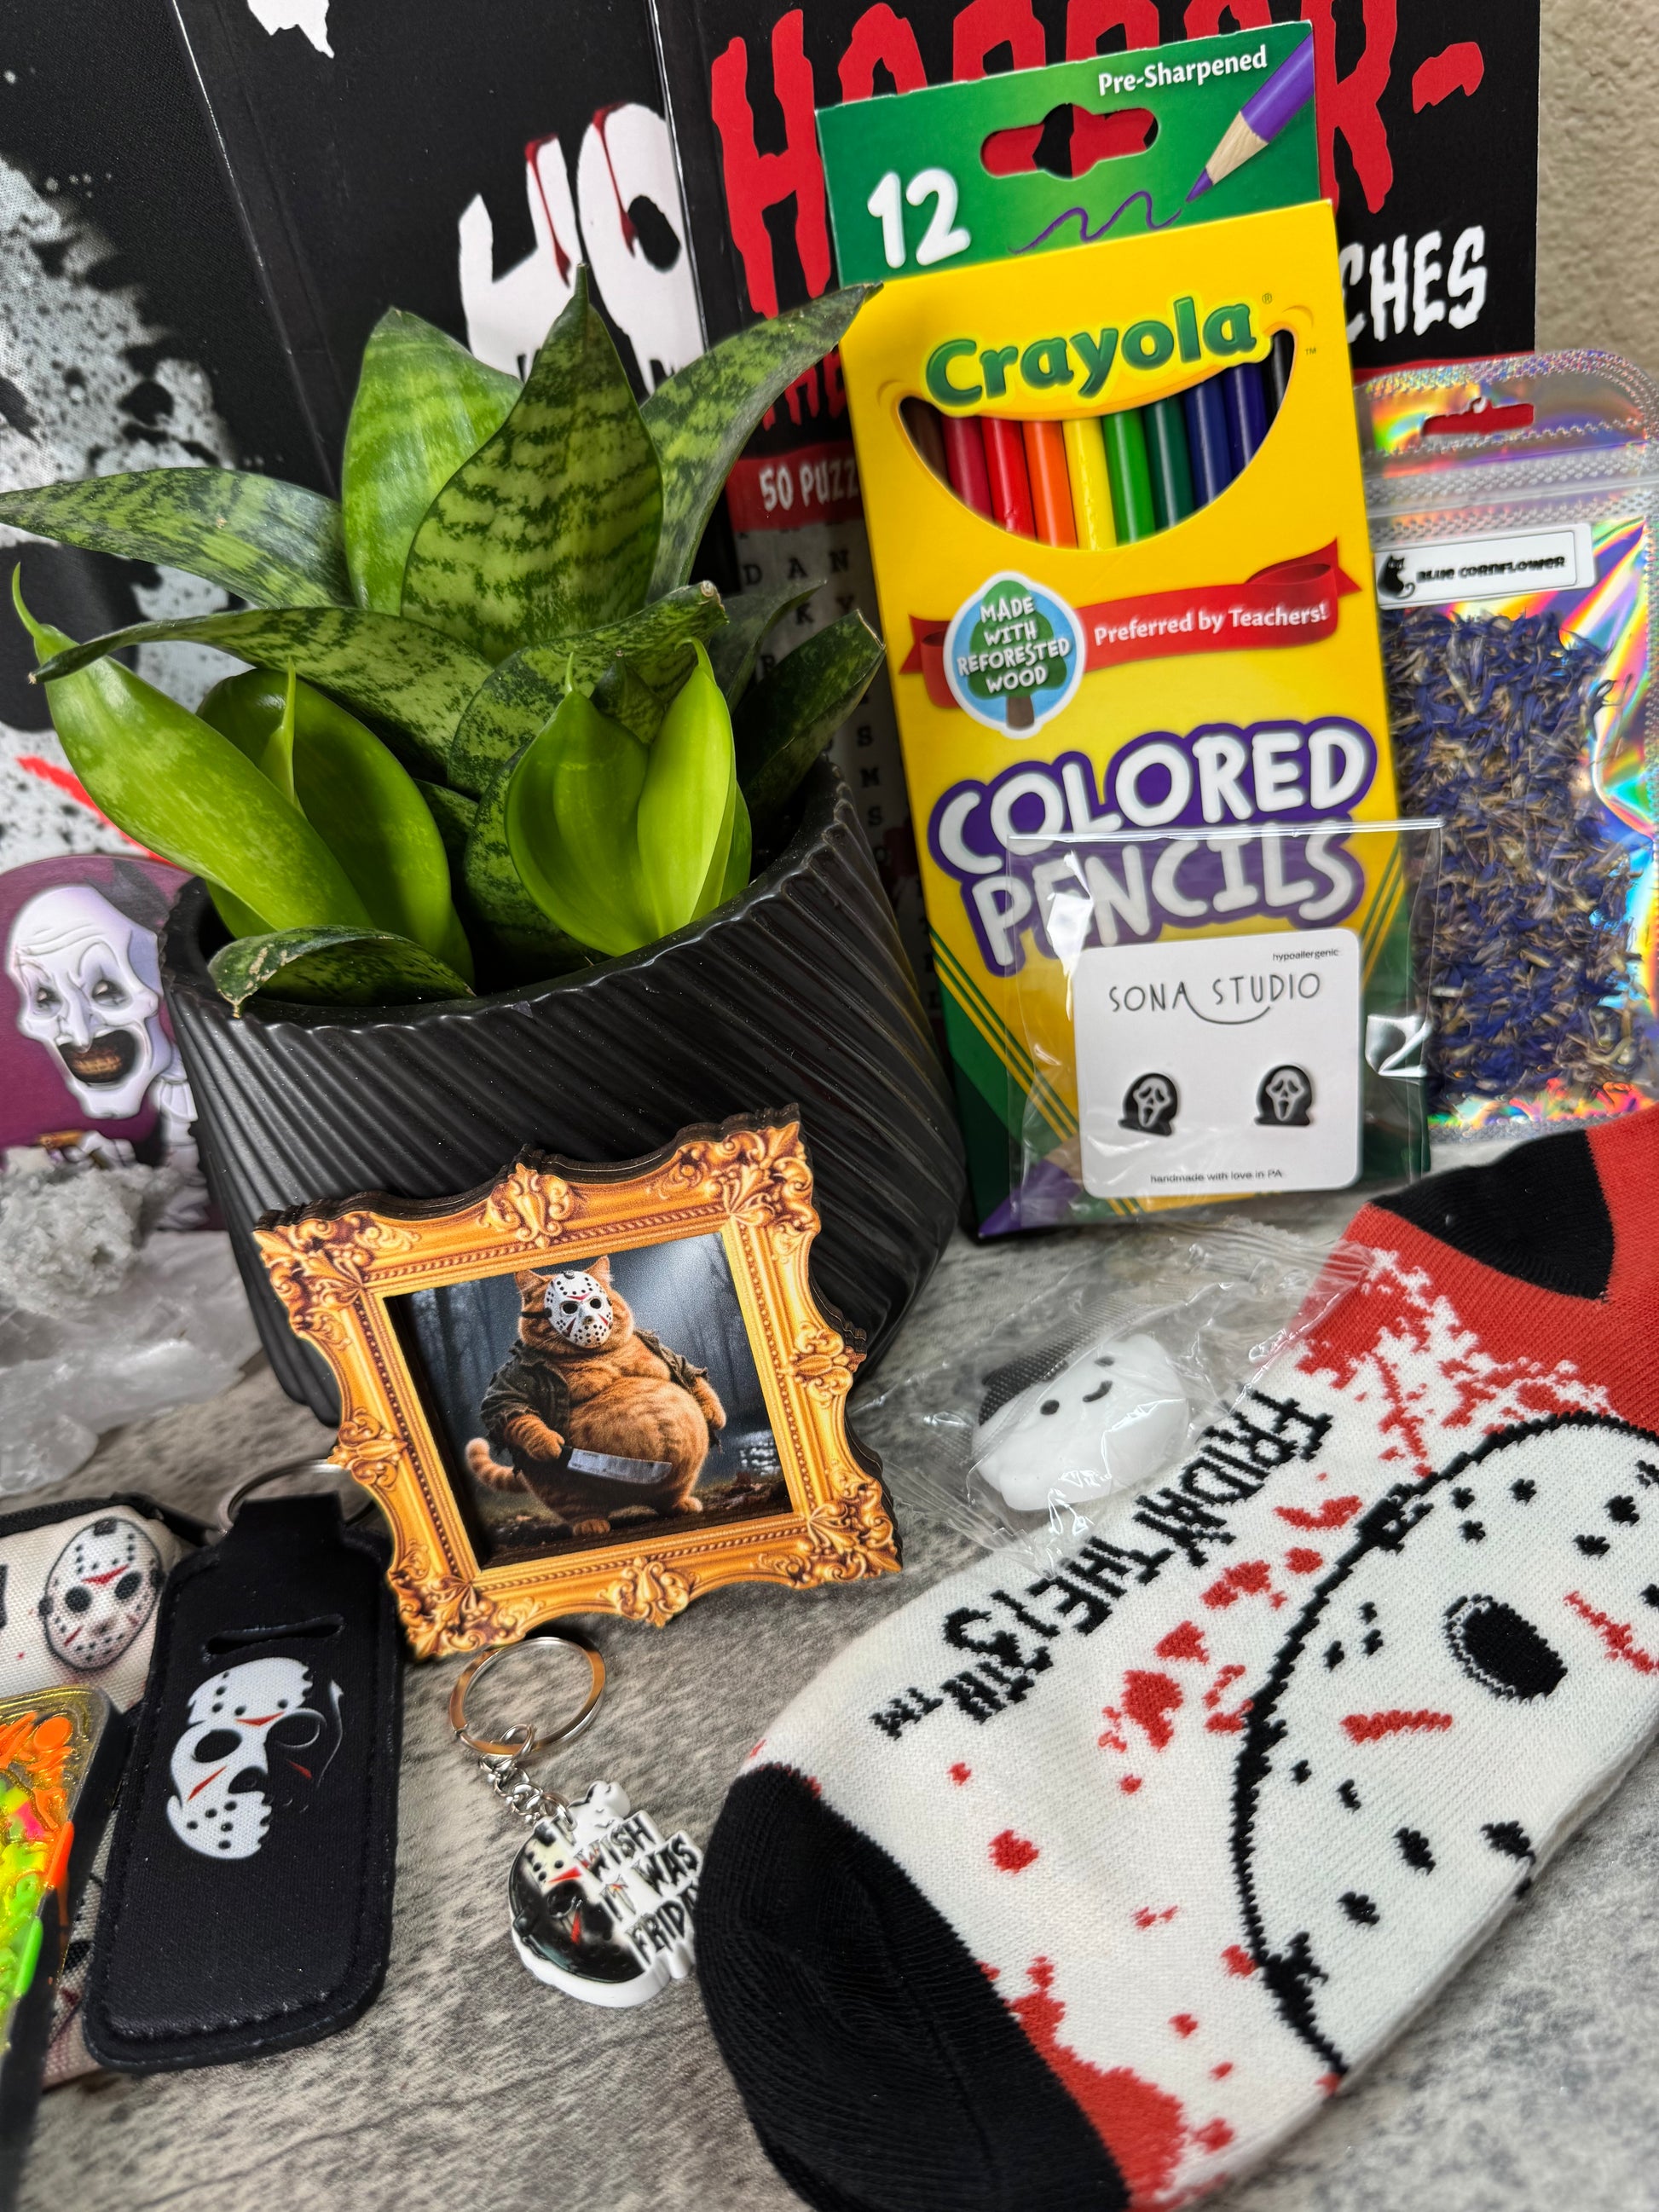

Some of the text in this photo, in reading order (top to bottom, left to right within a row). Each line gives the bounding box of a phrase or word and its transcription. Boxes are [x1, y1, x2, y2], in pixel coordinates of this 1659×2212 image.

[1099, 43, 1268, 96] Pre-Sharpened
[867, 168, 972, 269] 12
[924, 295, 1257, 407] Crayola
[759, 465, 794, 511] 50
[980, 597, 1036, 623] MADE
[983, 619, 1038, 647] WITH
[1094, 601, 1330, 646] Preferred by Teachers!
[957, 638, 1071, 677] REFORESTED
[986, 665, 1048, 694] WOOD
[938, 727, 1365, 875] COLORED
[1272, 948, 1340, 962] hypoallergenic
[1108, 973, 1321, 1013] SONA STUDIO
[1150, 1168, 1283, 1185] handmade with love in PA
[1133, 1383, 1334, 1568] FRIDAY
[1027, 1535, 1176, 1636] THE
[573, 1812, 657, 1883] WISH
[631, 1833, 699, 1898] WAS
